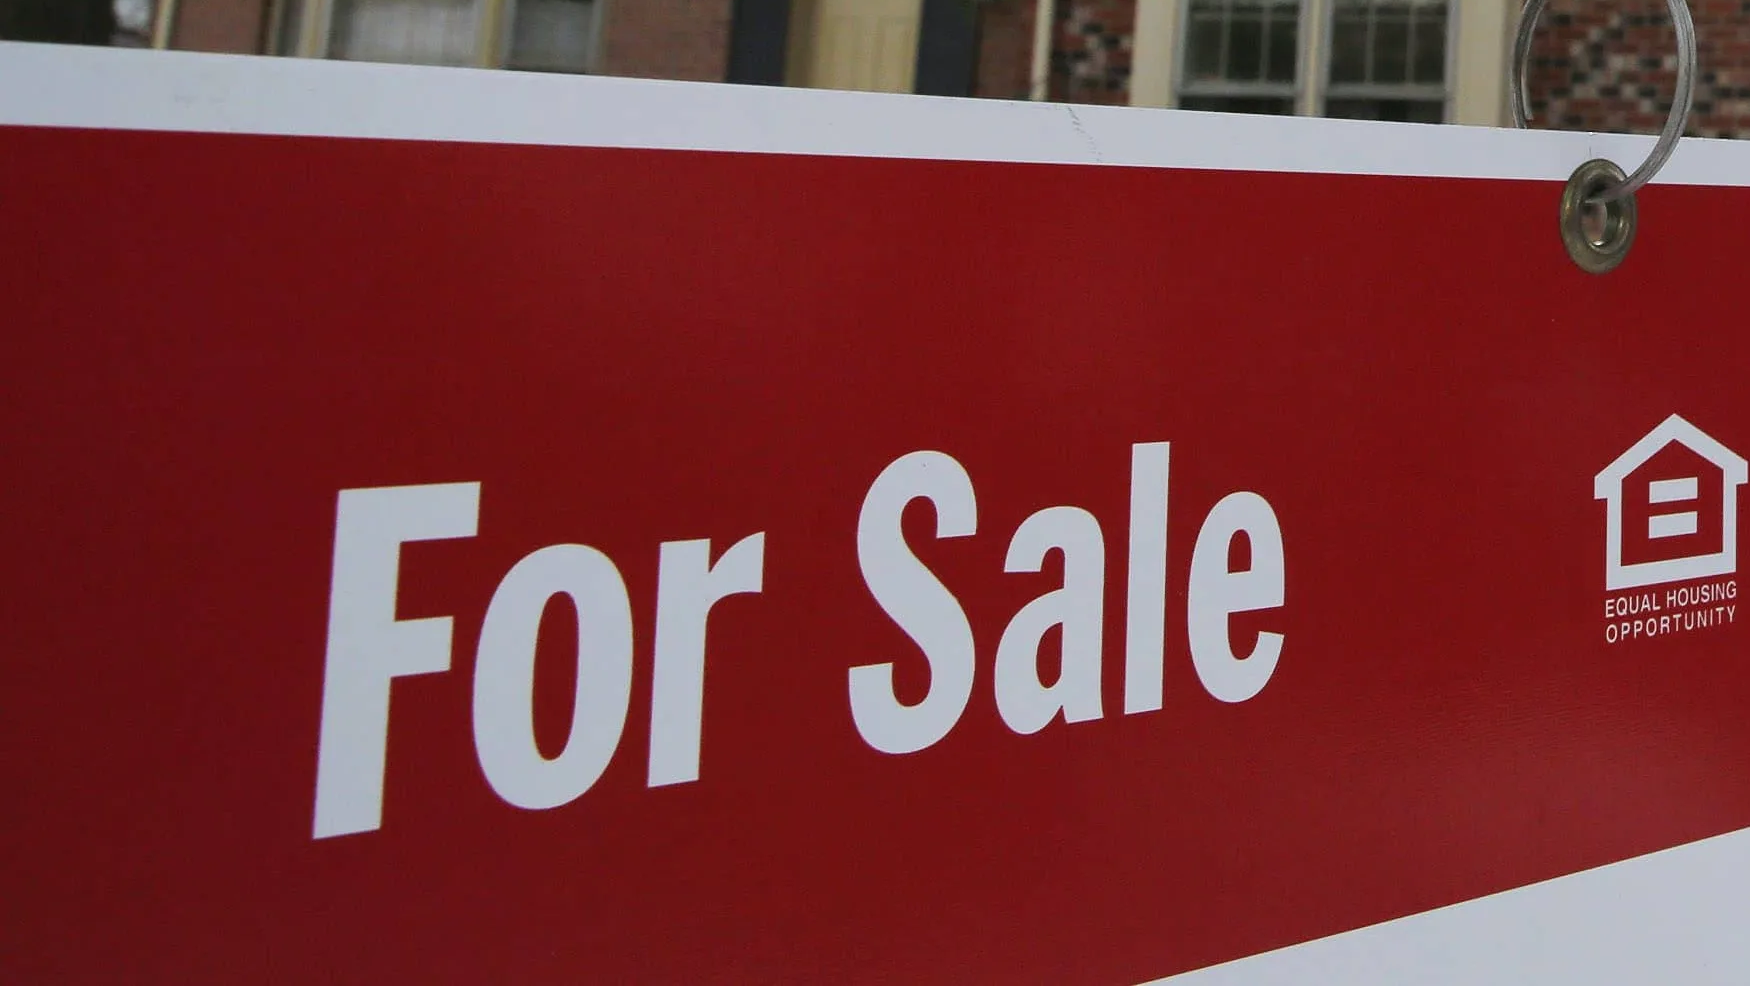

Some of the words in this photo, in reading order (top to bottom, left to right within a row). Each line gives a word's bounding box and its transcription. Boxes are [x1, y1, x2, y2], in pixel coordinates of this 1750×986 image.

[1604, 593, 1662, 619] EQUAL
[1666, 580, 1737, 608] HOUSING
[312, 481, 766, 840] For
[847, 440, 1286, 755] Sale
[1605, 605, 1736, 644] OPPORTUNITY
